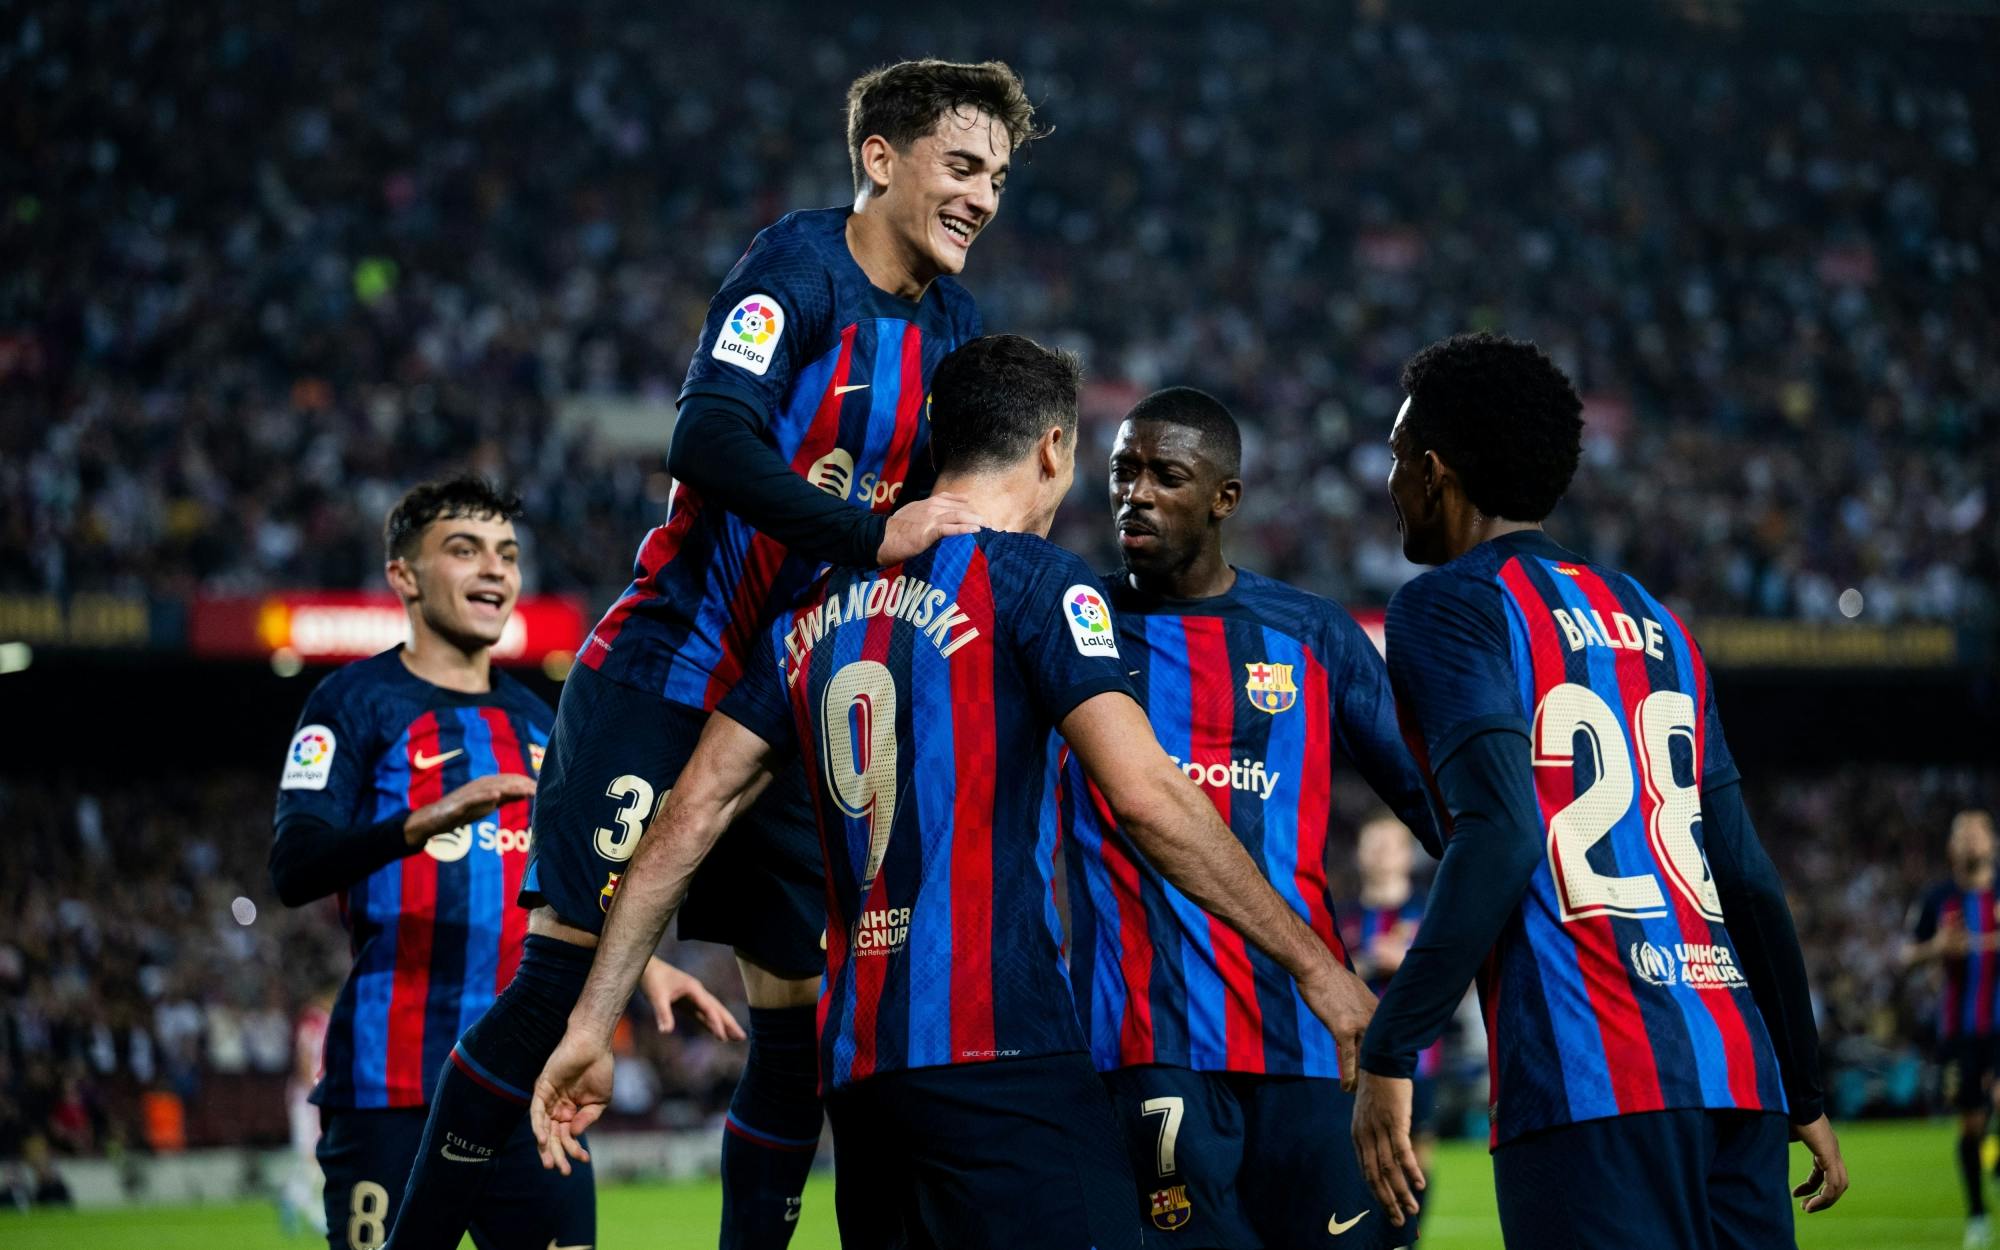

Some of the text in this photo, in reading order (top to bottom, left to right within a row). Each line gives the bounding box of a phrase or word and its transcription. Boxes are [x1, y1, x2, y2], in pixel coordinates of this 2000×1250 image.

[721, 339, 765, 364] LaLiga
[1081, 634, 1115, 649] LaLig
[1552, 607, 1664, 661] BALDE
[821, 660, 898, 891] 9
[593, 774, 673, 862] 3
[1530, 683, 1724, 923] 28
[857, 907, 911, 929] NHCR
[1674, 943, 1734, 965] UNHCR
[1681, 963, 1744, 983] ACNUR
[1141, 1096, 1185, 1178] 7
[347, 1180, 389, 1250] 8
